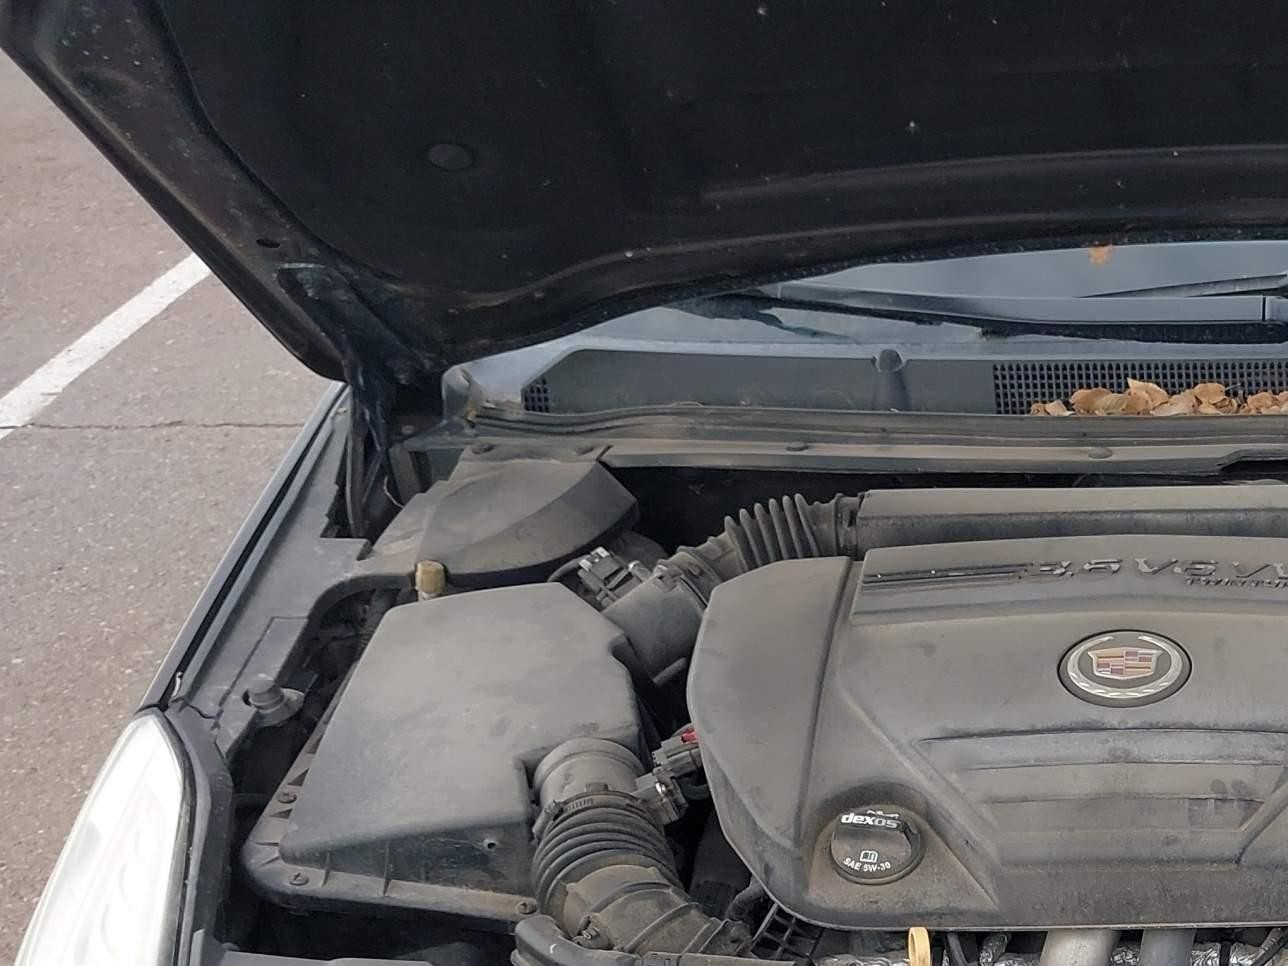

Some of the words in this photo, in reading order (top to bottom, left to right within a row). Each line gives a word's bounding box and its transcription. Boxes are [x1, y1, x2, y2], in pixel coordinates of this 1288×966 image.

[841, 812, 902, 829] dexos
[843, 857, 861, 872] SAE
[863, 862, 891, 873] 5W-30
